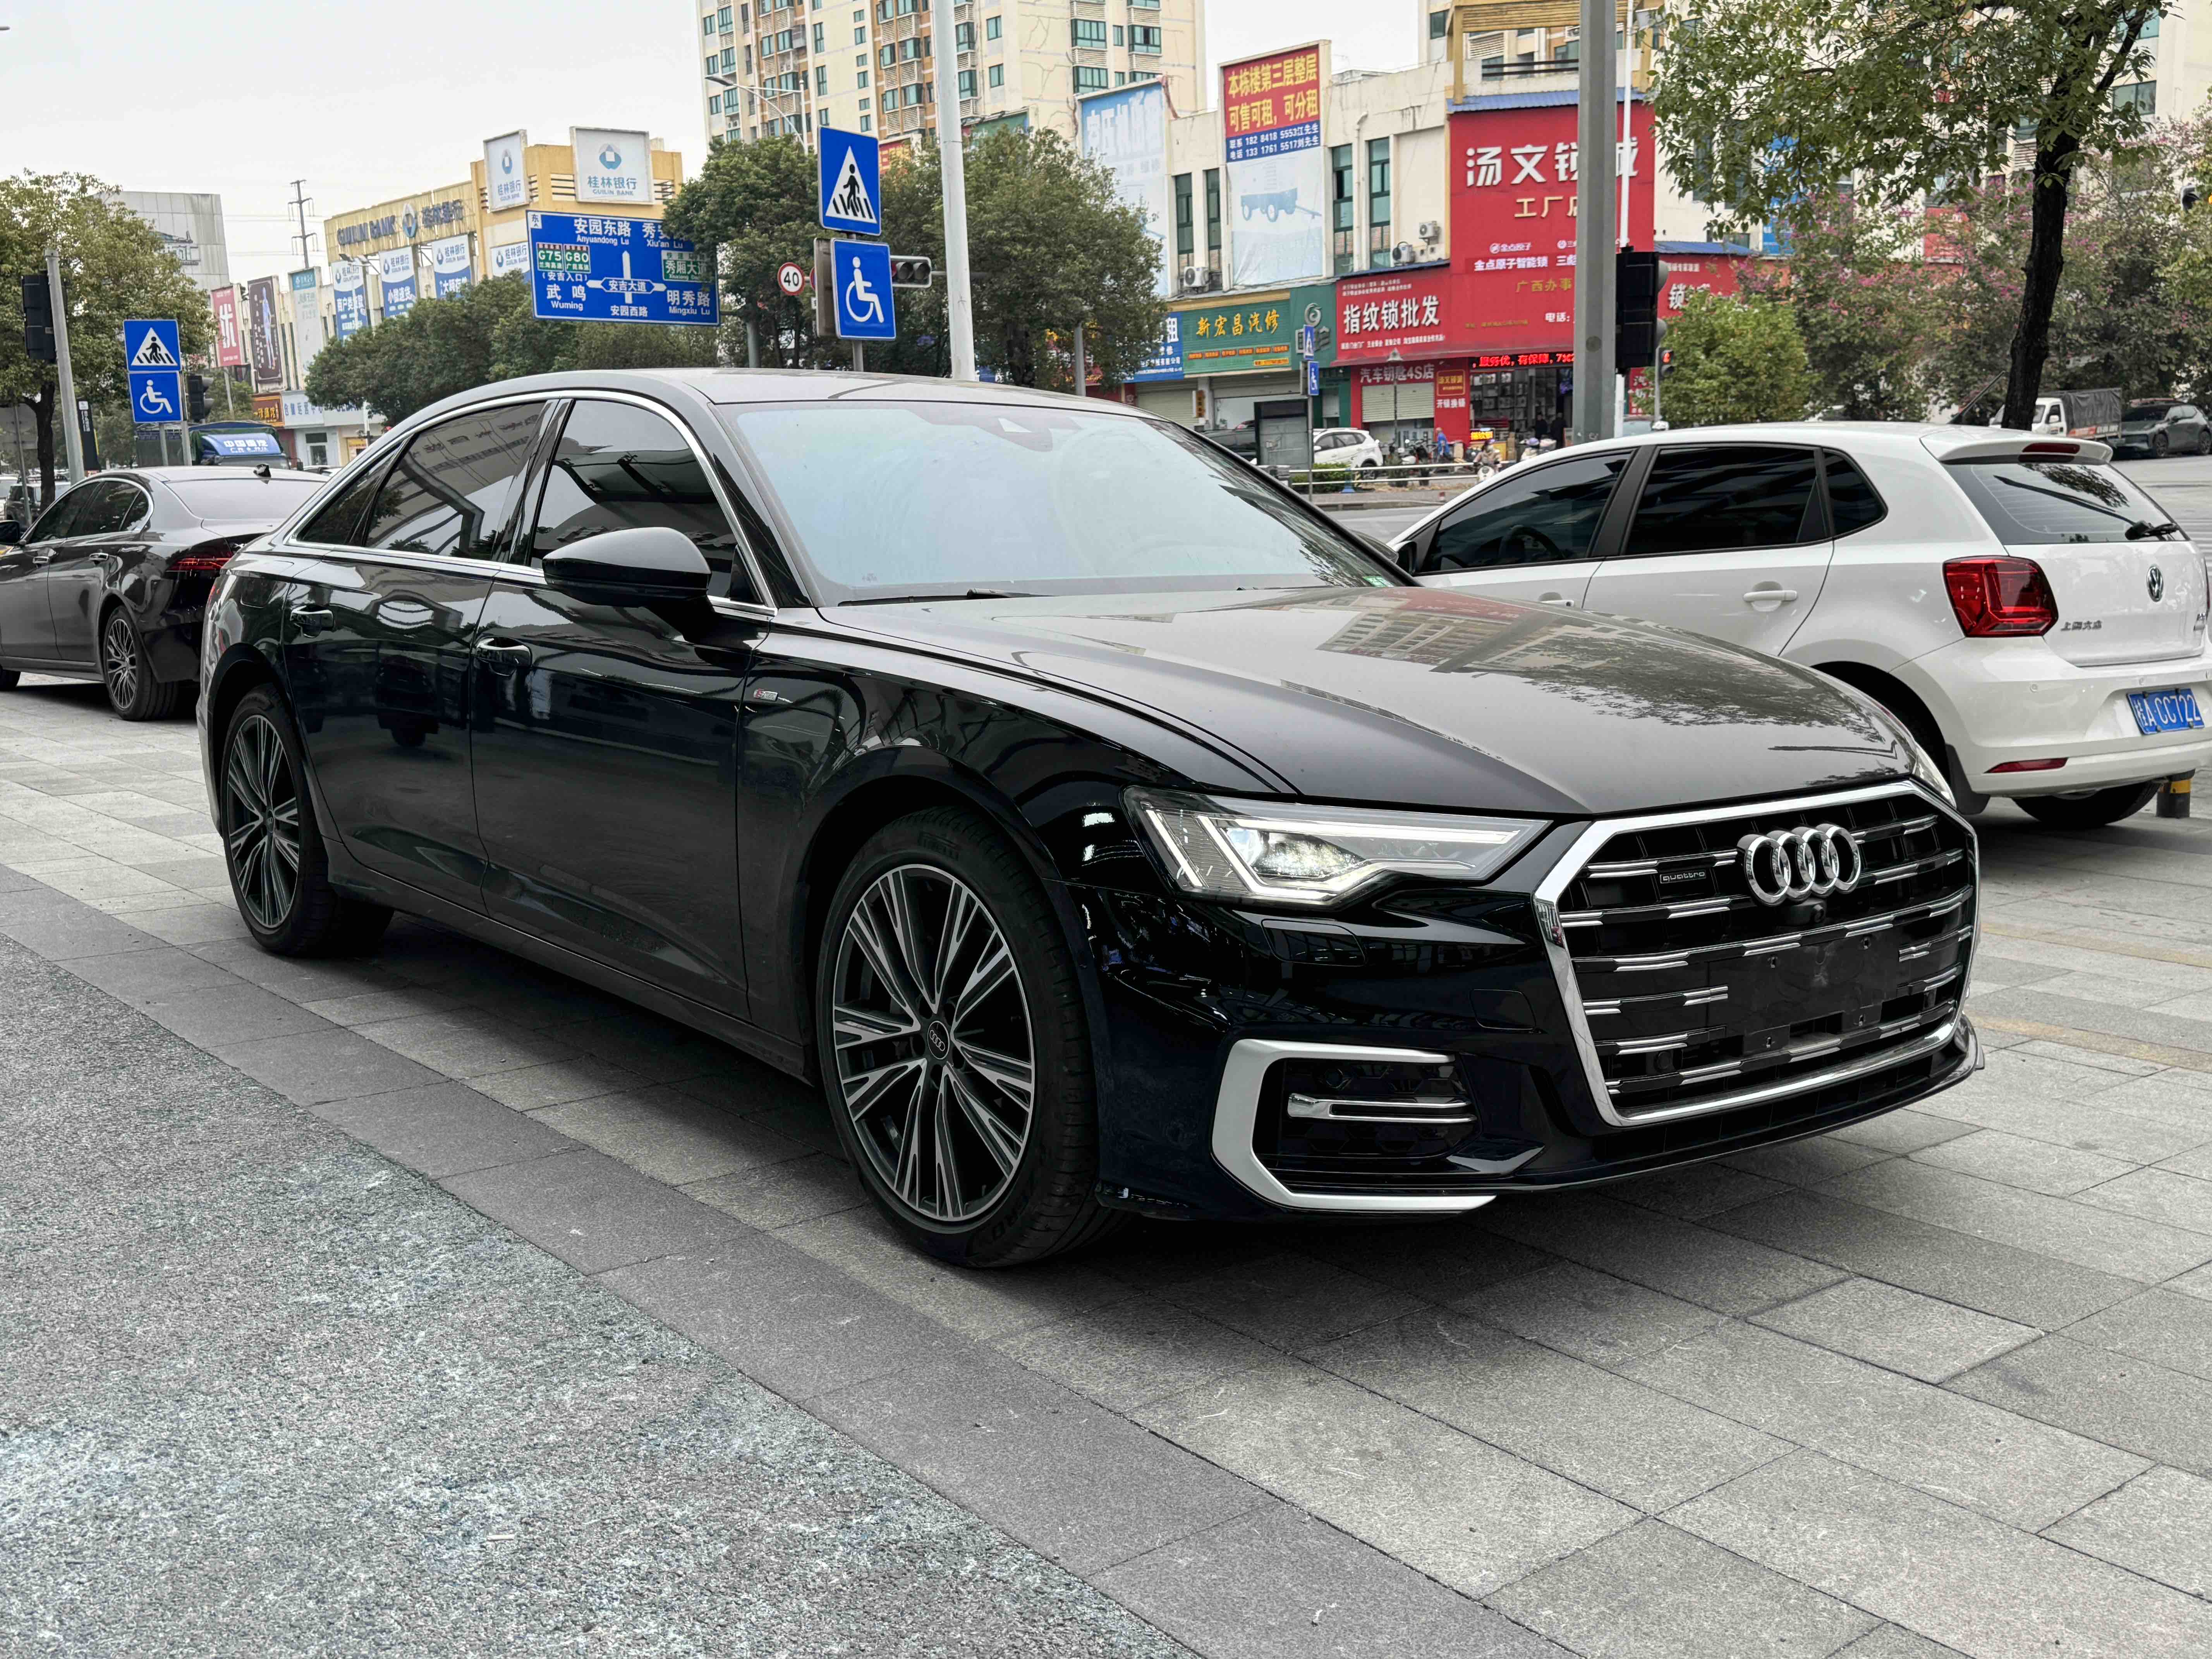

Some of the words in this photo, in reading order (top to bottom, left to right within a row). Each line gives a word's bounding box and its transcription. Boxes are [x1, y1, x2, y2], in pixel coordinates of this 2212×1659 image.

[1228, 53, 1317, 98] 本栋楼第三层整层
[1230, 149, 1243, 160] 电话
[1246, 148, 1258, 157] 133
[1261, 144, 1277, 154] 1761
[498, 180, 521, 196] 桂林银行
[588, 175, 637, 190] 桂林银行
[532, 214, 539, 223] 东
[574, 218, 631, 237] 安园东路
[577, 235, 618, 246] Anyuandong
[647, 239, 669, 247] Xiu'an
[539, 250, 562, 261] G75
[566, 252, 589, 262] G80
[609, 280, 646, 292] 安吉大道
[784, 271, 799, 286] 40
[546, 283, 586, 301] 武鸣
[667, 290, 710, 307] 明秀路
[551, 301, 583, 311] Wuming
[611, 305, 648, 317] 安园西路
[669, 306, 697, 316] Mingxiu
[1343, 295, 1440, 334] 指纹锁批发
[1196, 309, 1279, 338] 新宏昌汽修
[1360, 364, 1434, 383] 汽车钥匙4S店
[1663, 871, 1705, 883] quattro
